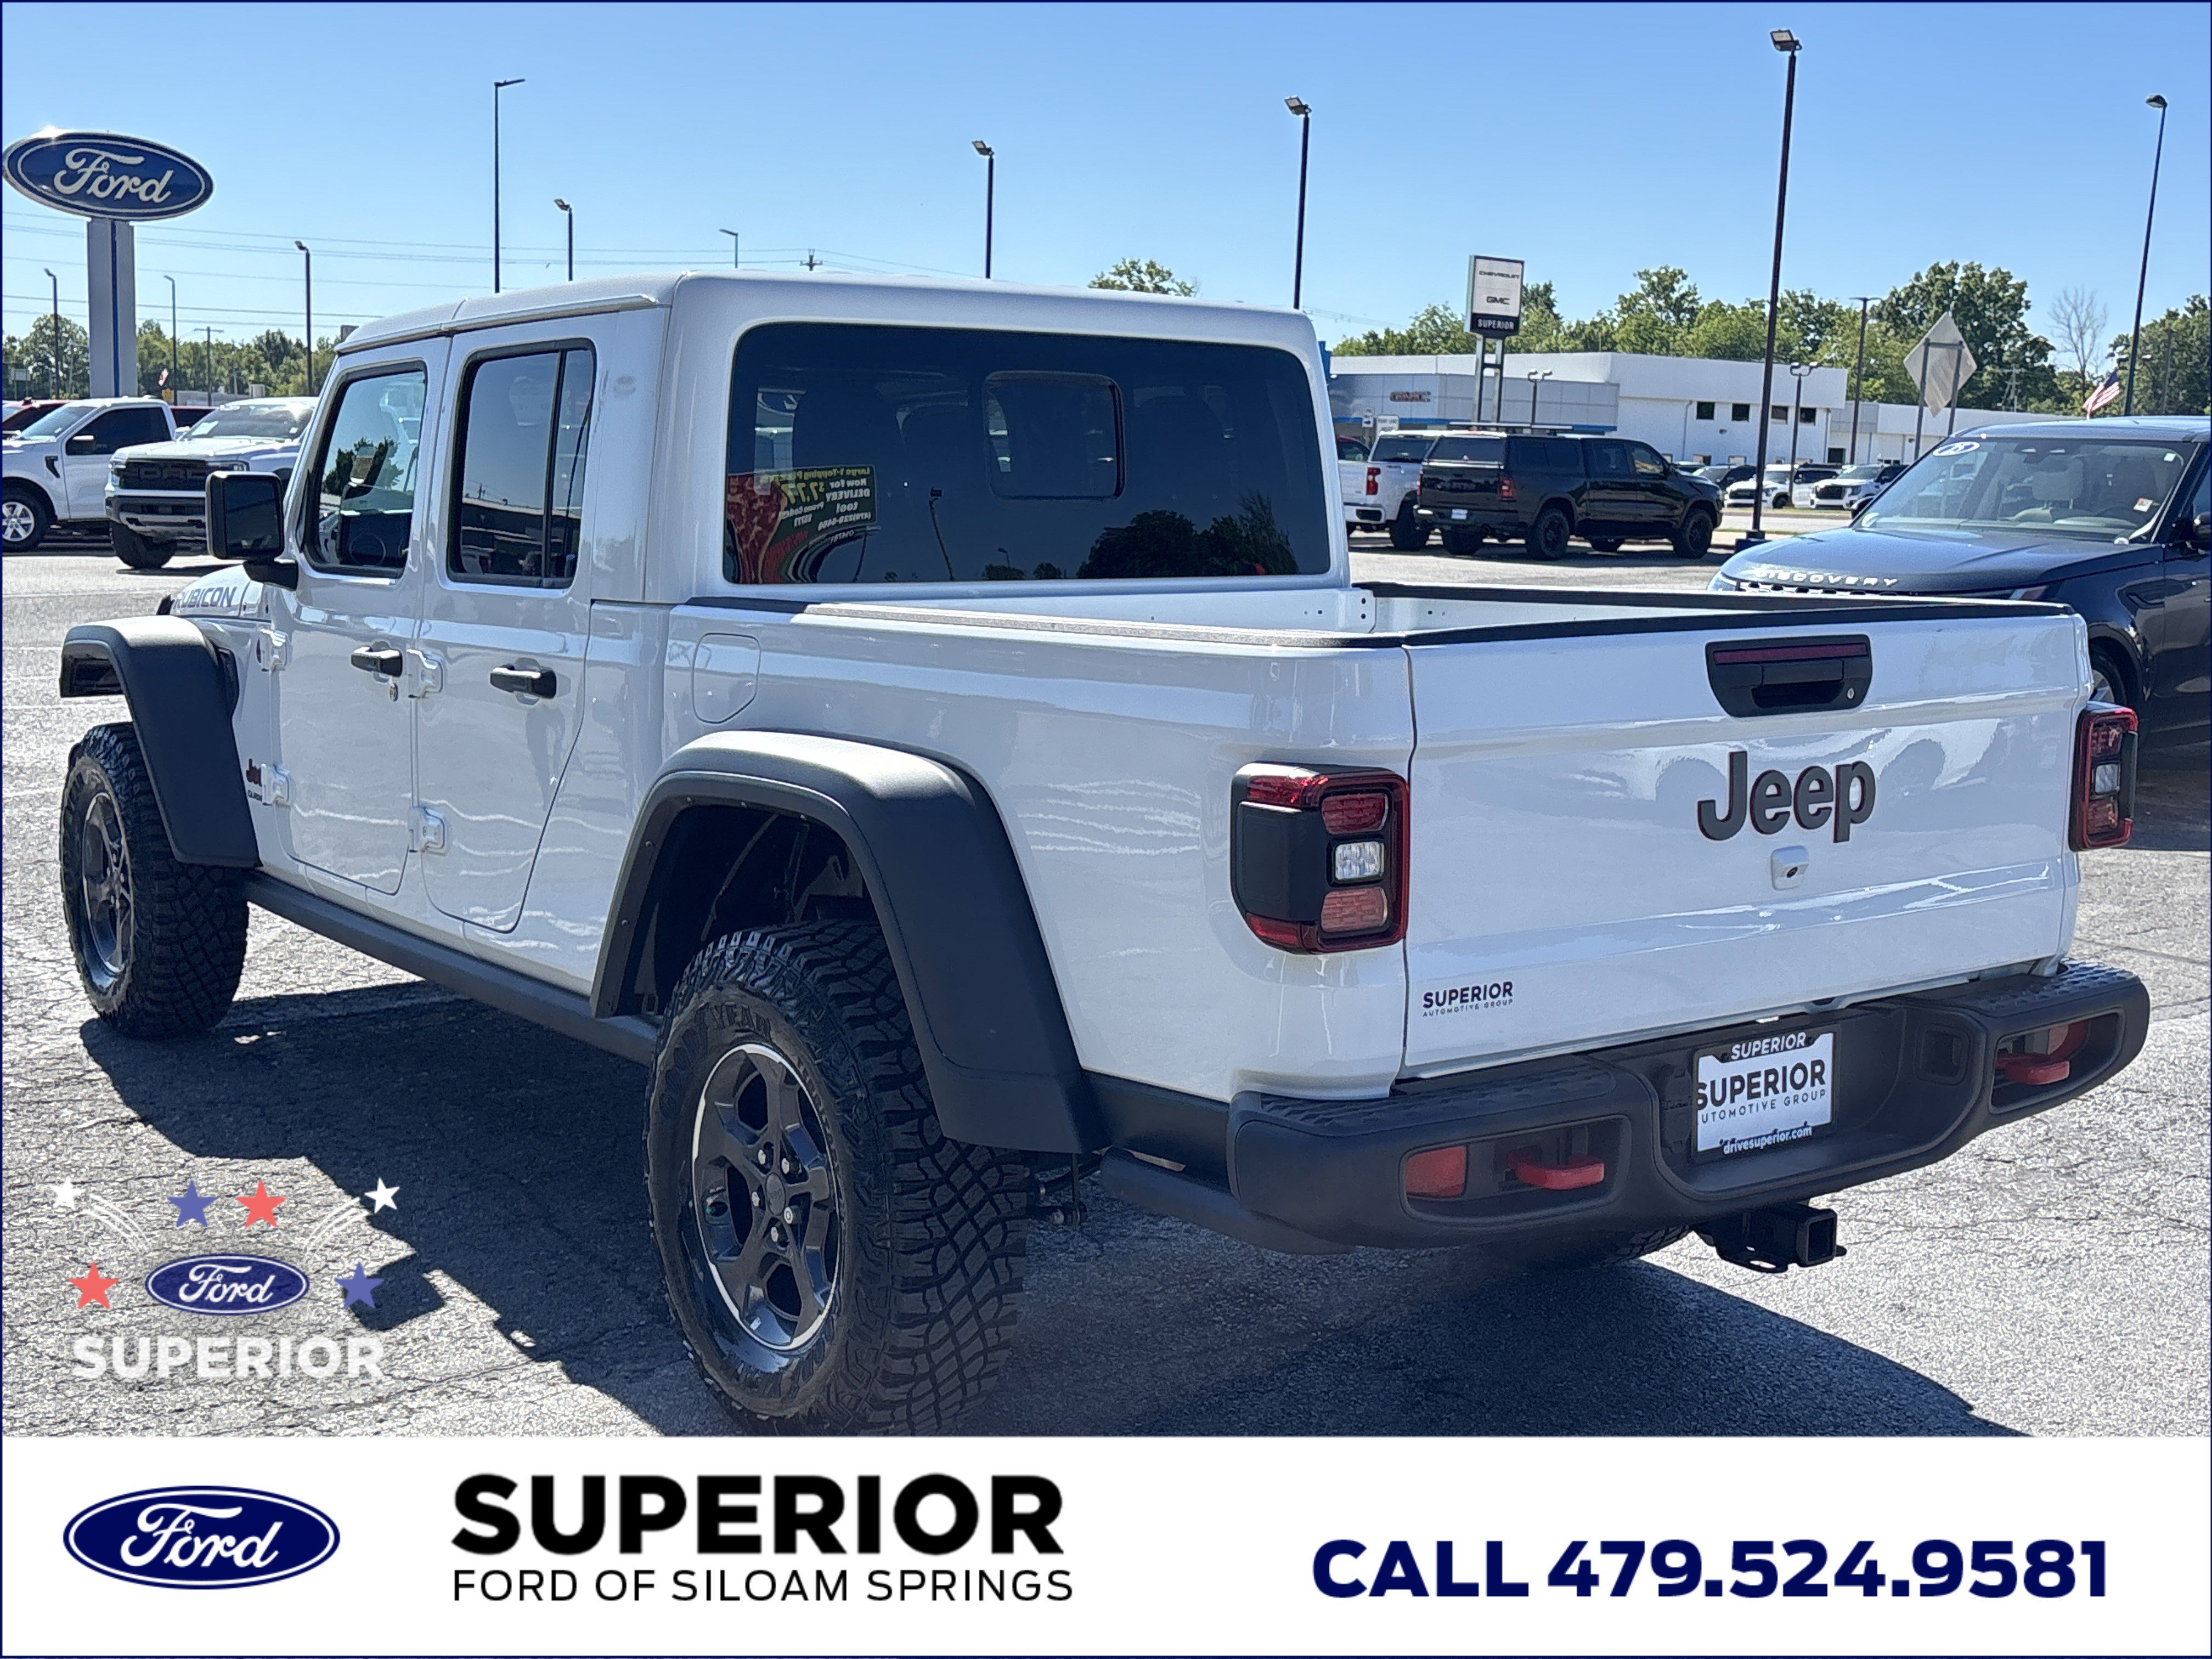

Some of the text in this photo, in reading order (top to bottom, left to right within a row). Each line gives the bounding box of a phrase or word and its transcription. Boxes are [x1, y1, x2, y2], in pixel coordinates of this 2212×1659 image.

[54, 147, 173, 204] Ford
[1486, 295, 1510, 306] GMC
[1477, 318, 1515, 330] SUPERIOR
[172, 586, 238, 610] RUBICON
[1697, 751, 1876, 843] Jeep
[1422, 981, 1514, 1009] SUPERIOR
[1422, 998, 1513, 1018] AUTOMOTIVE GROUP
[1731, 1031, 1807, 1060] SUPERIOR
[1696, 1059, 1826, 1111] SUPERIOR
[1701, 1089, 1826, 1124] UTOMOTIVE GROUP
[1723, 1125, 1813, 1155] drivesuperior.com
